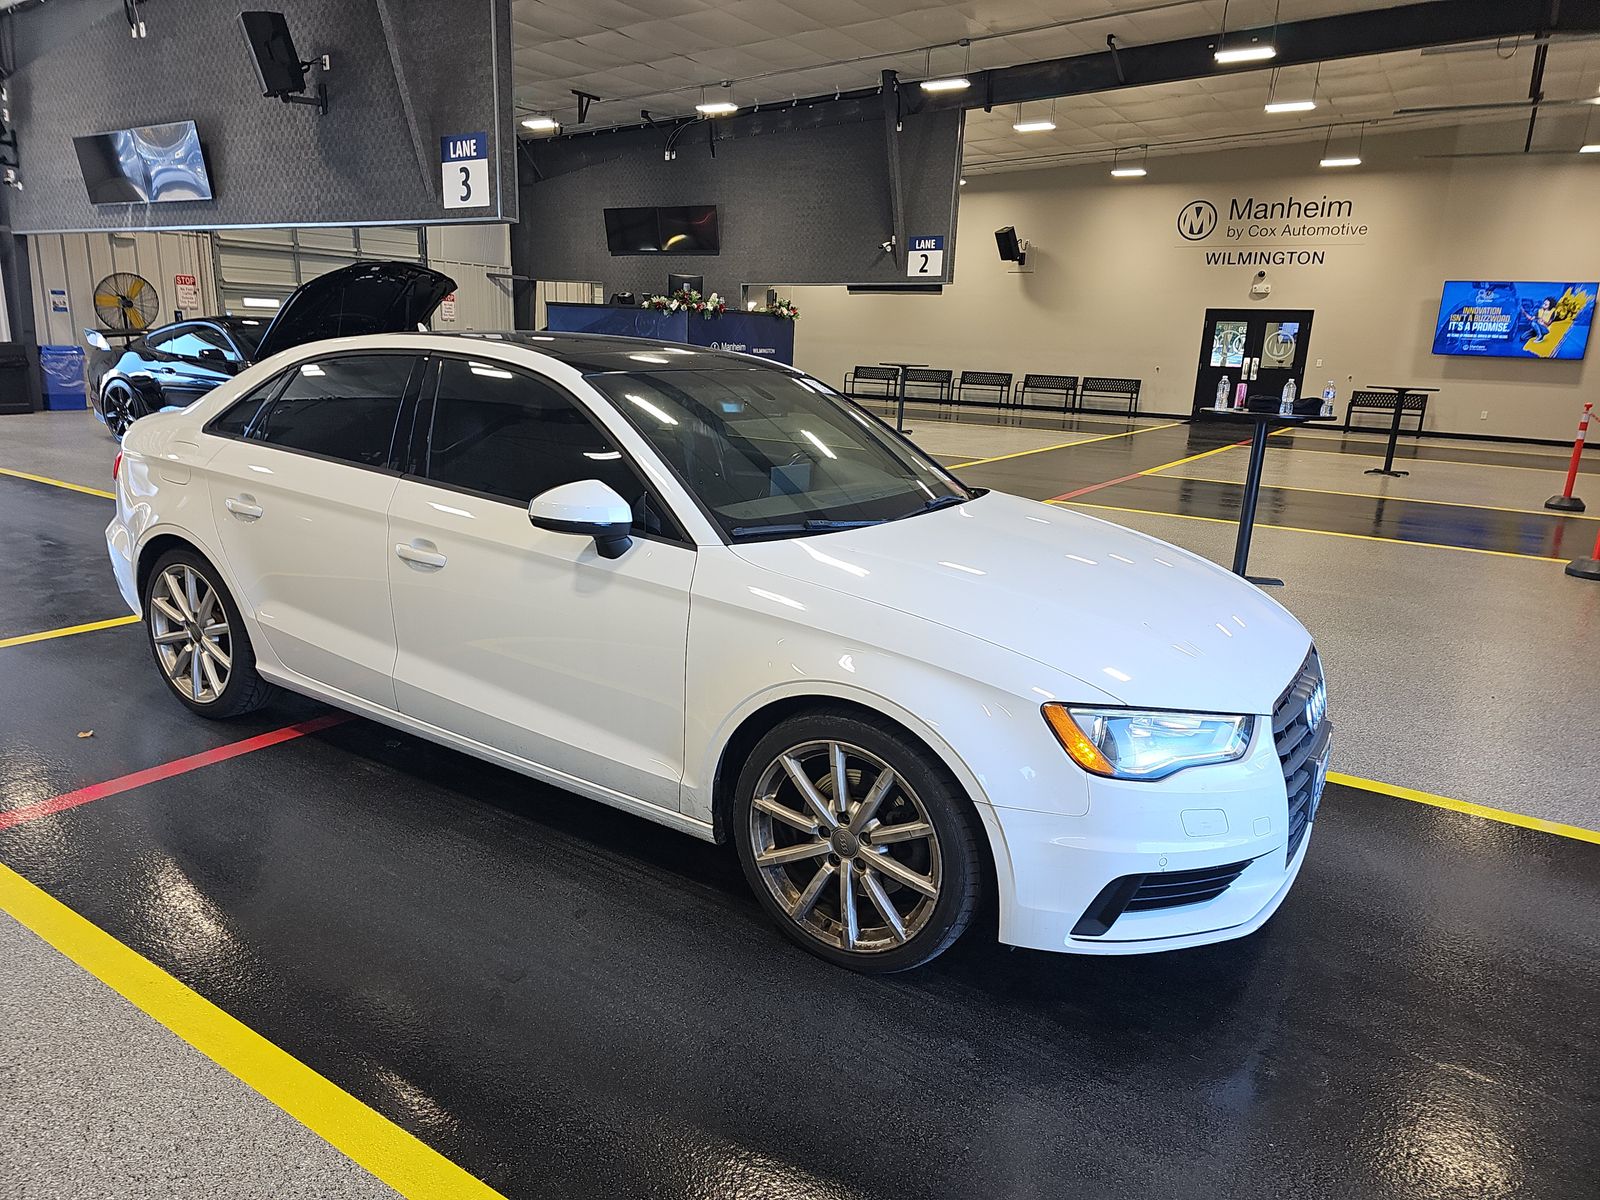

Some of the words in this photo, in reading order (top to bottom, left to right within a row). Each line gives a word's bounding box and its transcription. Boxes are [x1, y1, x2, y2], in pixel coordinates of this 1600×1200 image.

[449, 139, 477, 158] LANE
[459, 166, 471, 202] 3
[1229, 195, 1353, 220] Manheim
[1226, 226, 1244, 240] by
[1248, 225, 1277, 237] Cox
[1280, 223, 1368, 237] Automotive
[915, 239, 936, 250] LANE
[919, 253, 929, 274] 2
[1205, 251, 1325, 265] WILMINGTON
[176, 276, 195, 285] STOP
[1463, 306, 1502, 315] INNOVATION
[1450, 314, 1467, 322] ISN'T
[1467, 314, 1473, 322] A
[1448, 321, 1464, 331] IT'S
[1464, 321, 1471, 331] A
[1471, 321, 1510, 333] PROMISE.
[721, 342, 746, 351] Manheim
